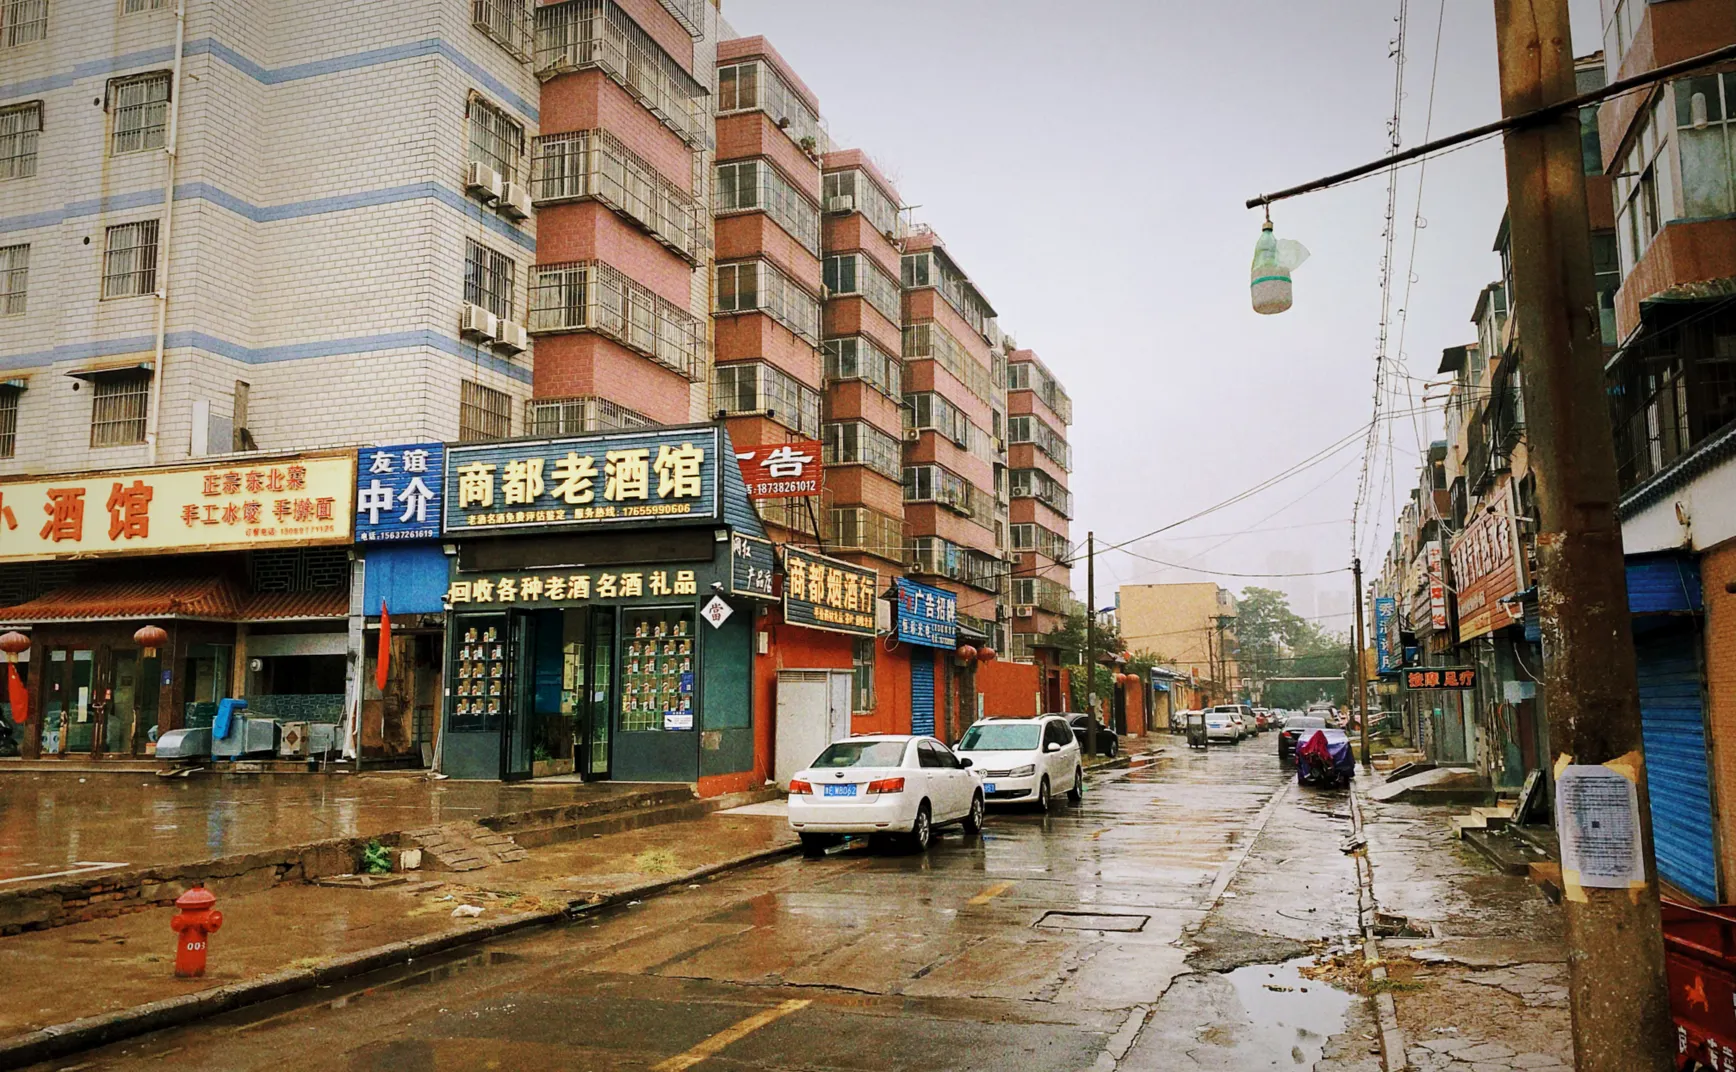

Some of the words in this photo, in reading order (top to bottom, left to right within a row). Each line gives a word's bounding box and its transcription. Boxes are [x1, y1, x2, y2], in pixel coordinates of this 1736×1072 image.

[369, 449, 429, 473] 友谊
[456, 442, 704, 508] 商都老酒馆
[735, 446, 814, 478] 告
[202, 465, 307, 496] 正宗东北菜
[180, 500, 263, 527] 手工水饺
[357, 477, 435, 525] 中介
[450, 575, 590, 603] 回收各种老酒
[596, 573, 643, 598] 名酒
[649, 570, 697, 596] 礼品
[789, 557, 875, 613] 商都烟酒行
